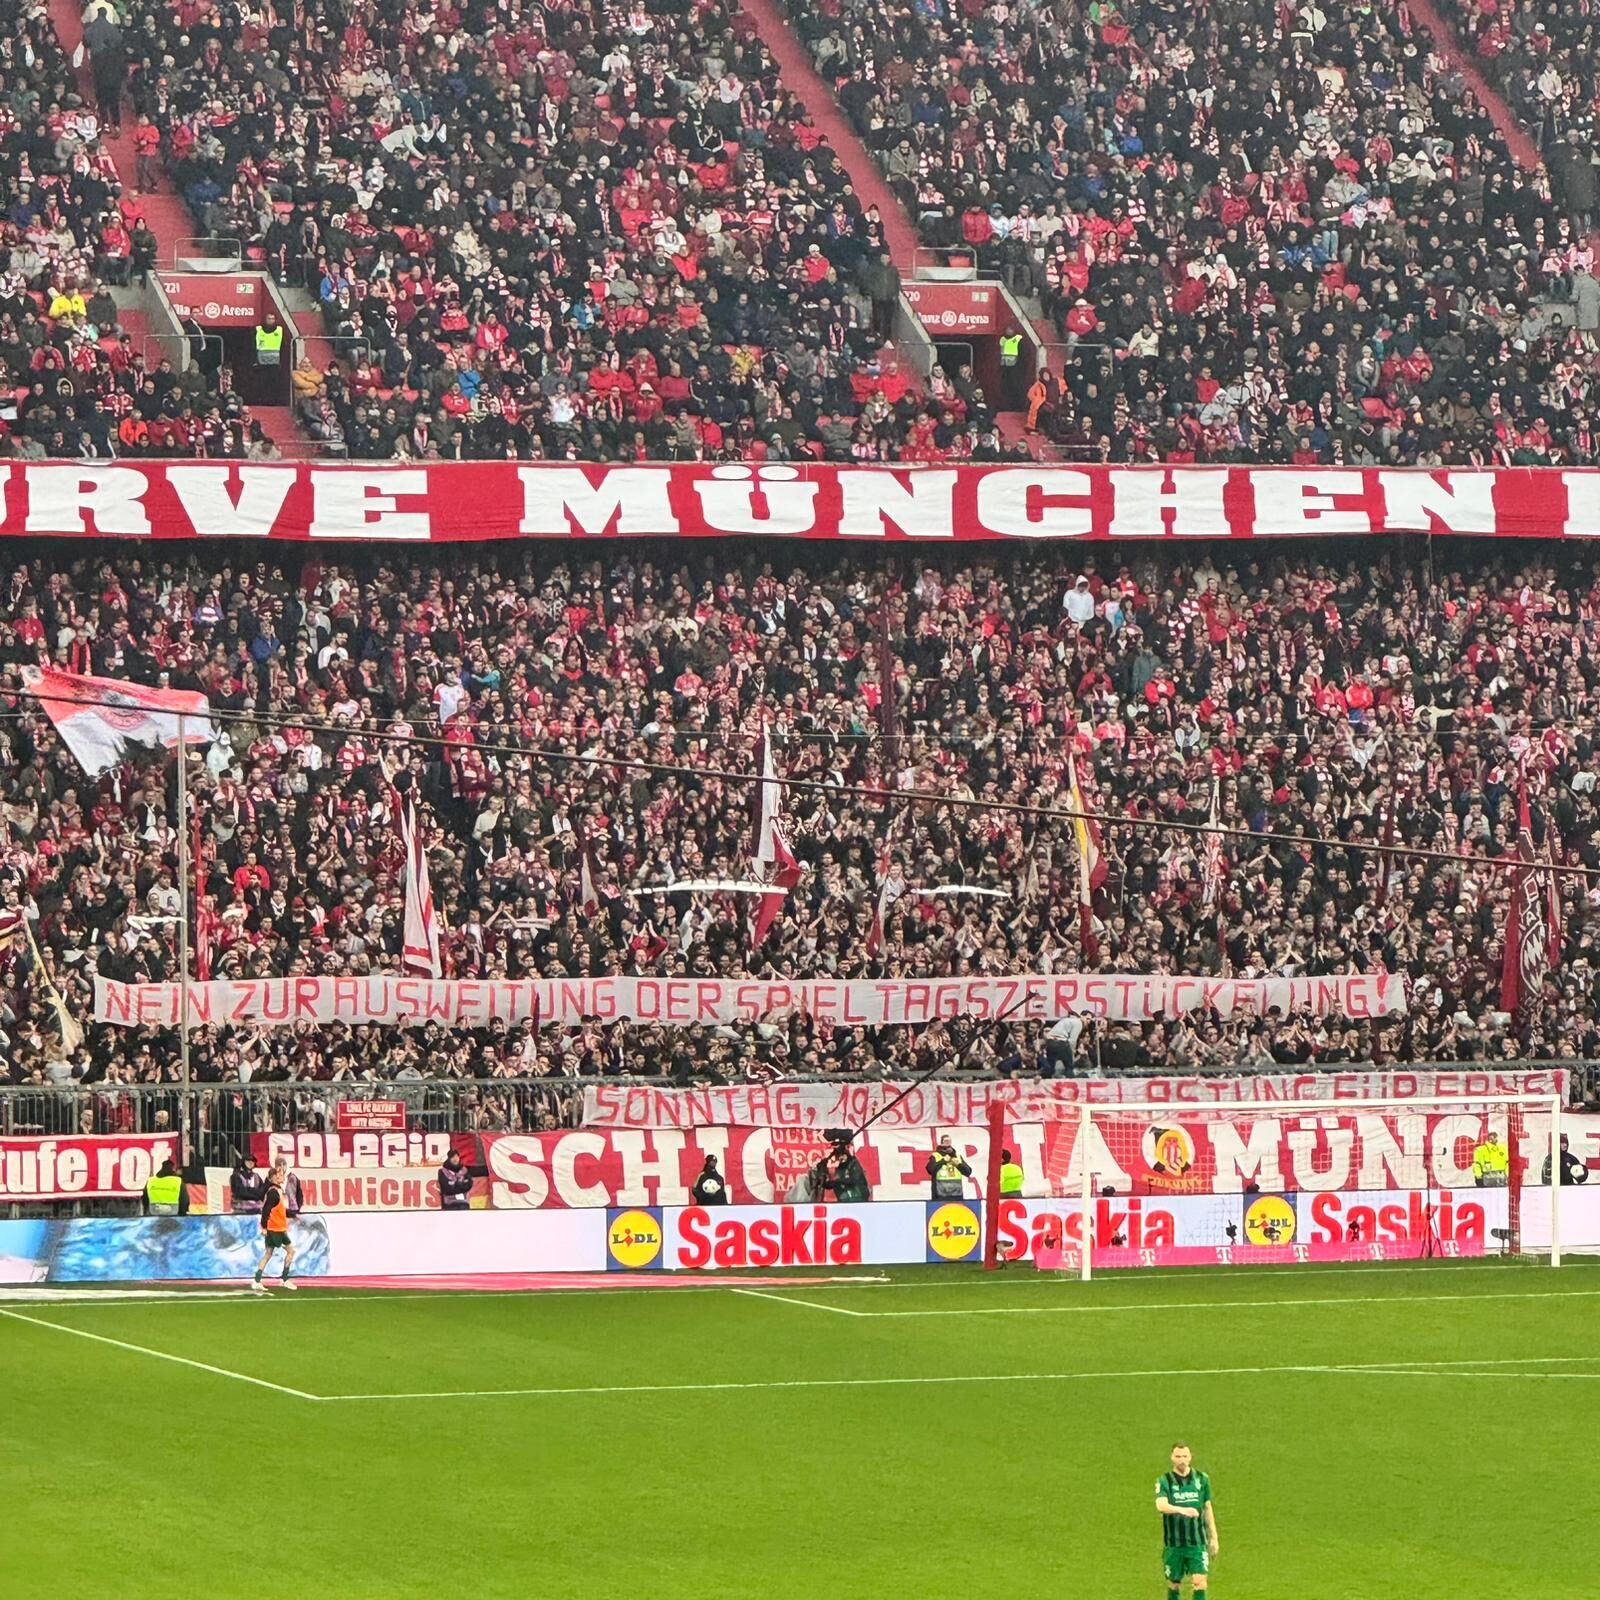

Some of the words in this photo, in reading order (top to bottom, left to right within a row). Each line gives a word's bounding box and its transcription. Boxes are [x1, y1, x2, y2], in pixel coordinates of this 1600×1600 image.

[222, 304, 254, 317] Arena
[957, 313, 990, 324] Arena
[0, 465, 431, 539] RVE
[517, 465, 1496, 538] MÜNCHEN
[105, 981, 212, 1023] NEIN
[231, 977, 320, 1021] ZUR
[333, 976, 615, 1021] AUSWEITUNG
[636, 981, 723, 1020] DER
[595, 1084, 817, 1127] SONNTAG,
[97, 1141, 172, 1191] rot
[489, 1126, 1133, 1209] SCHICERIA
[677, 1205, 863, 1268] Saskia
[997, 1199, 1175, 1261] Saskia
[1310, 1191, 1486, 1244] Saskia
